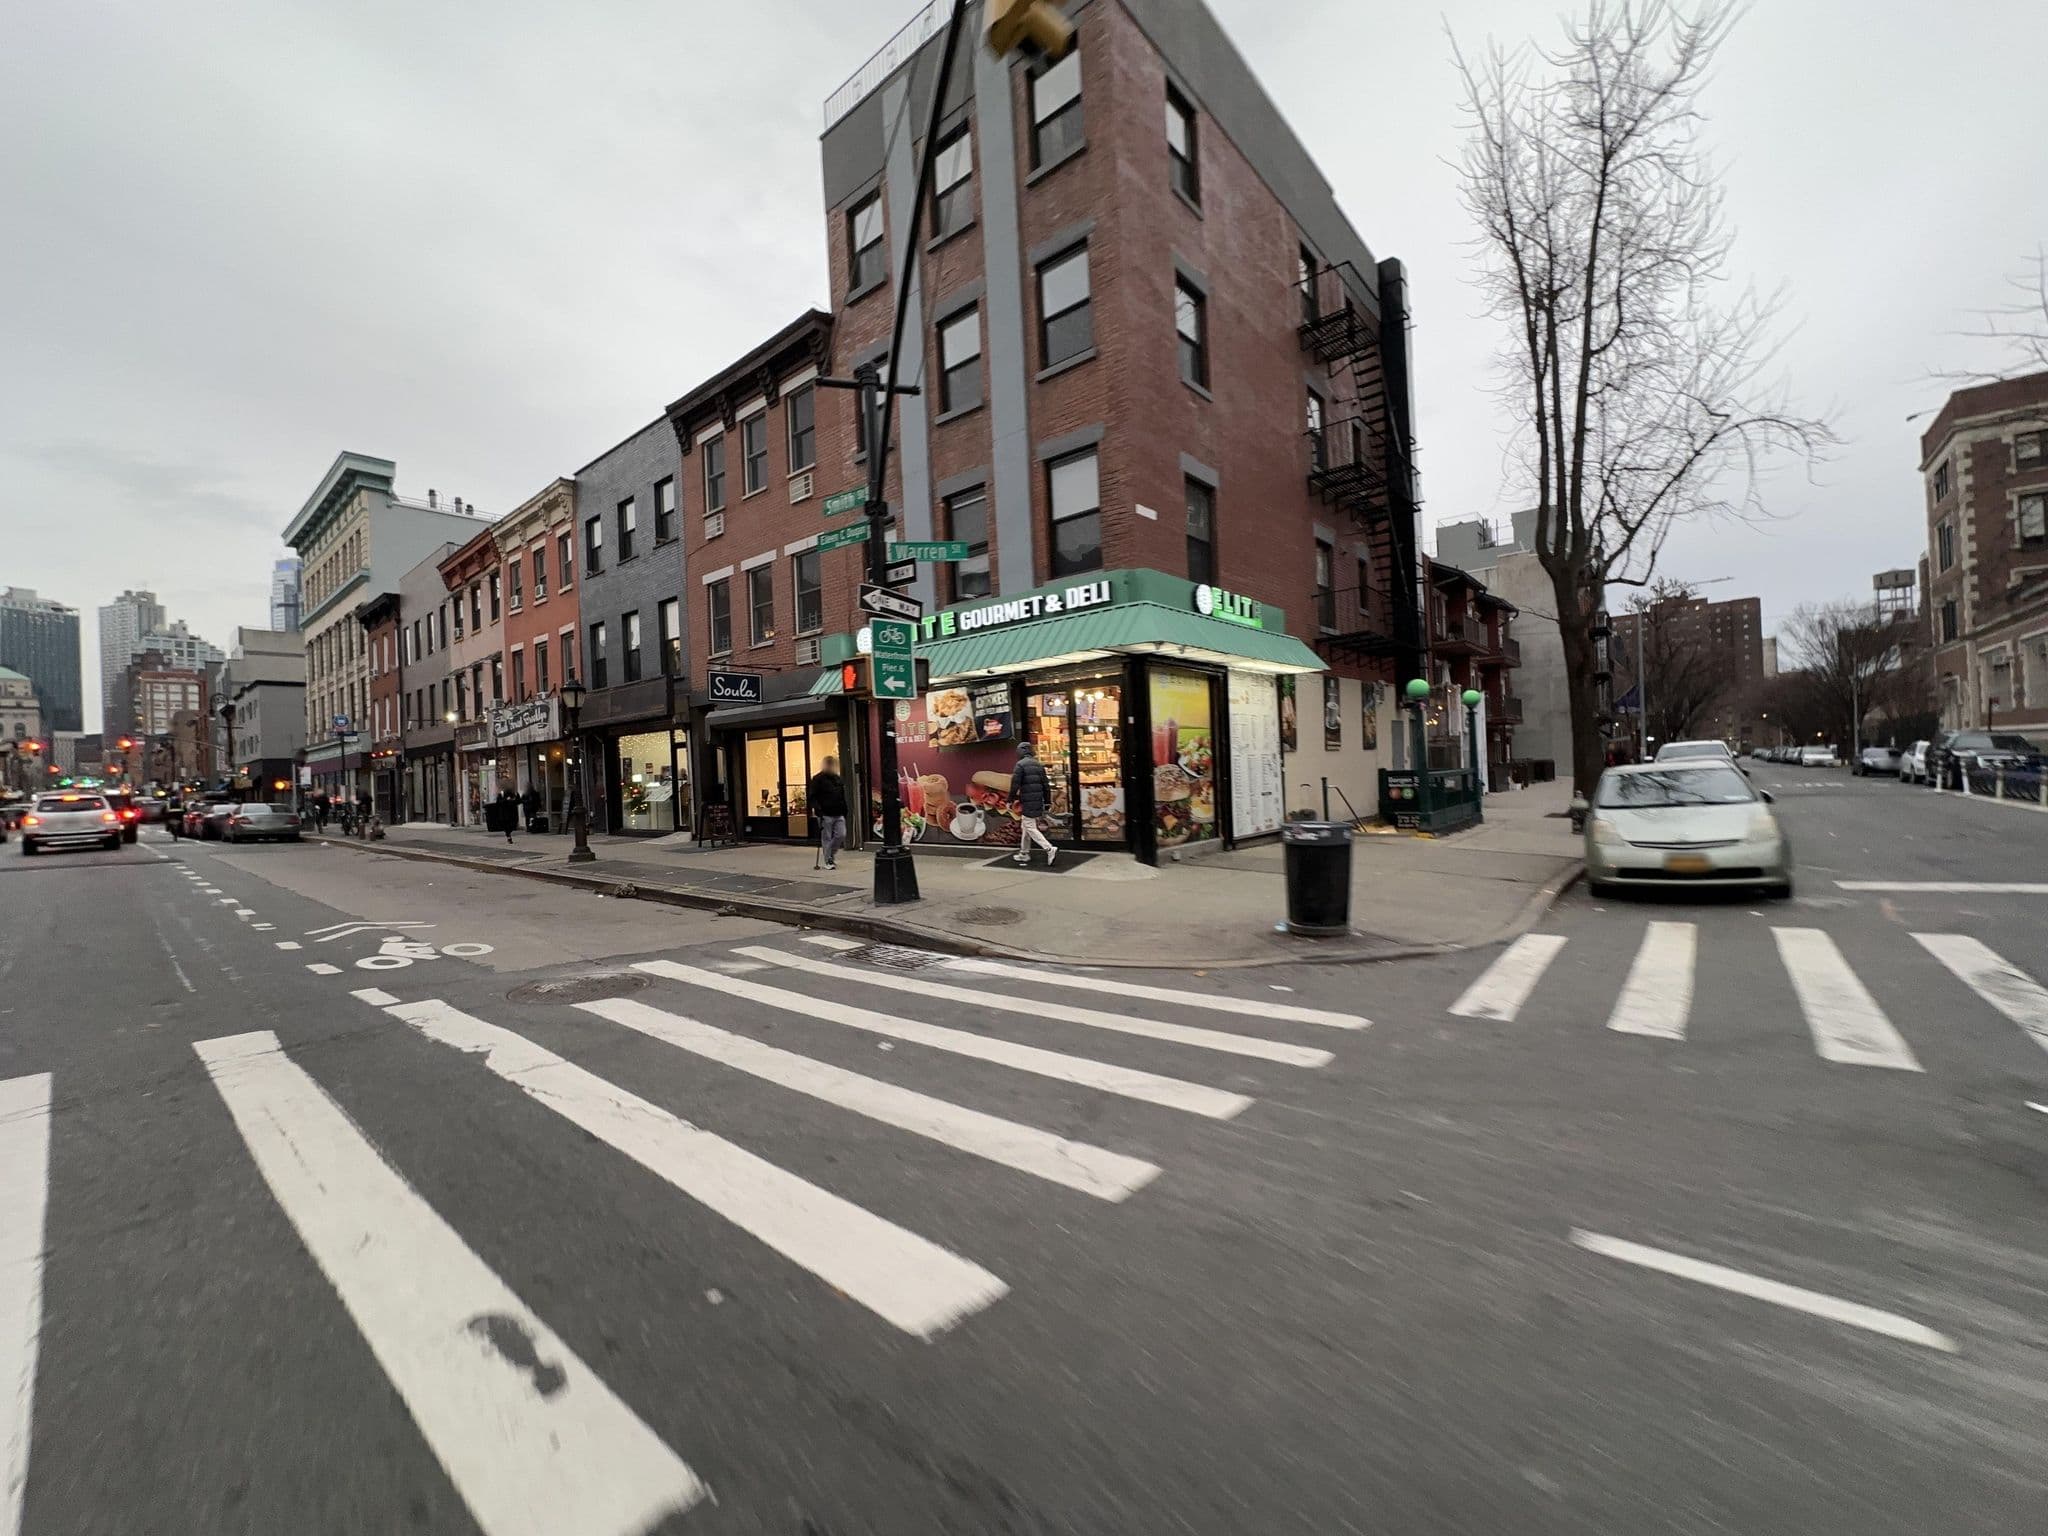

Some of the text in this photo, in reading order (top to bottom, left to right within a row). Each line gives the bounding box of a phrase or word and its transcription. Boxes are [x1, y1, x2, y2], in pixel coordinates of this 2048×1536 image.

[895, 544, 947, 560] Warren
[870, 594, 917, 615] ONE WAY
[959, 595, 1044, 631] GOURMET
[1044, 594, 1064, 613] &
[1064, 580, 1111, 609] DELI
[1211, 586, 1263, 619] ELITE
[713, 676, 757, 698] Soula
